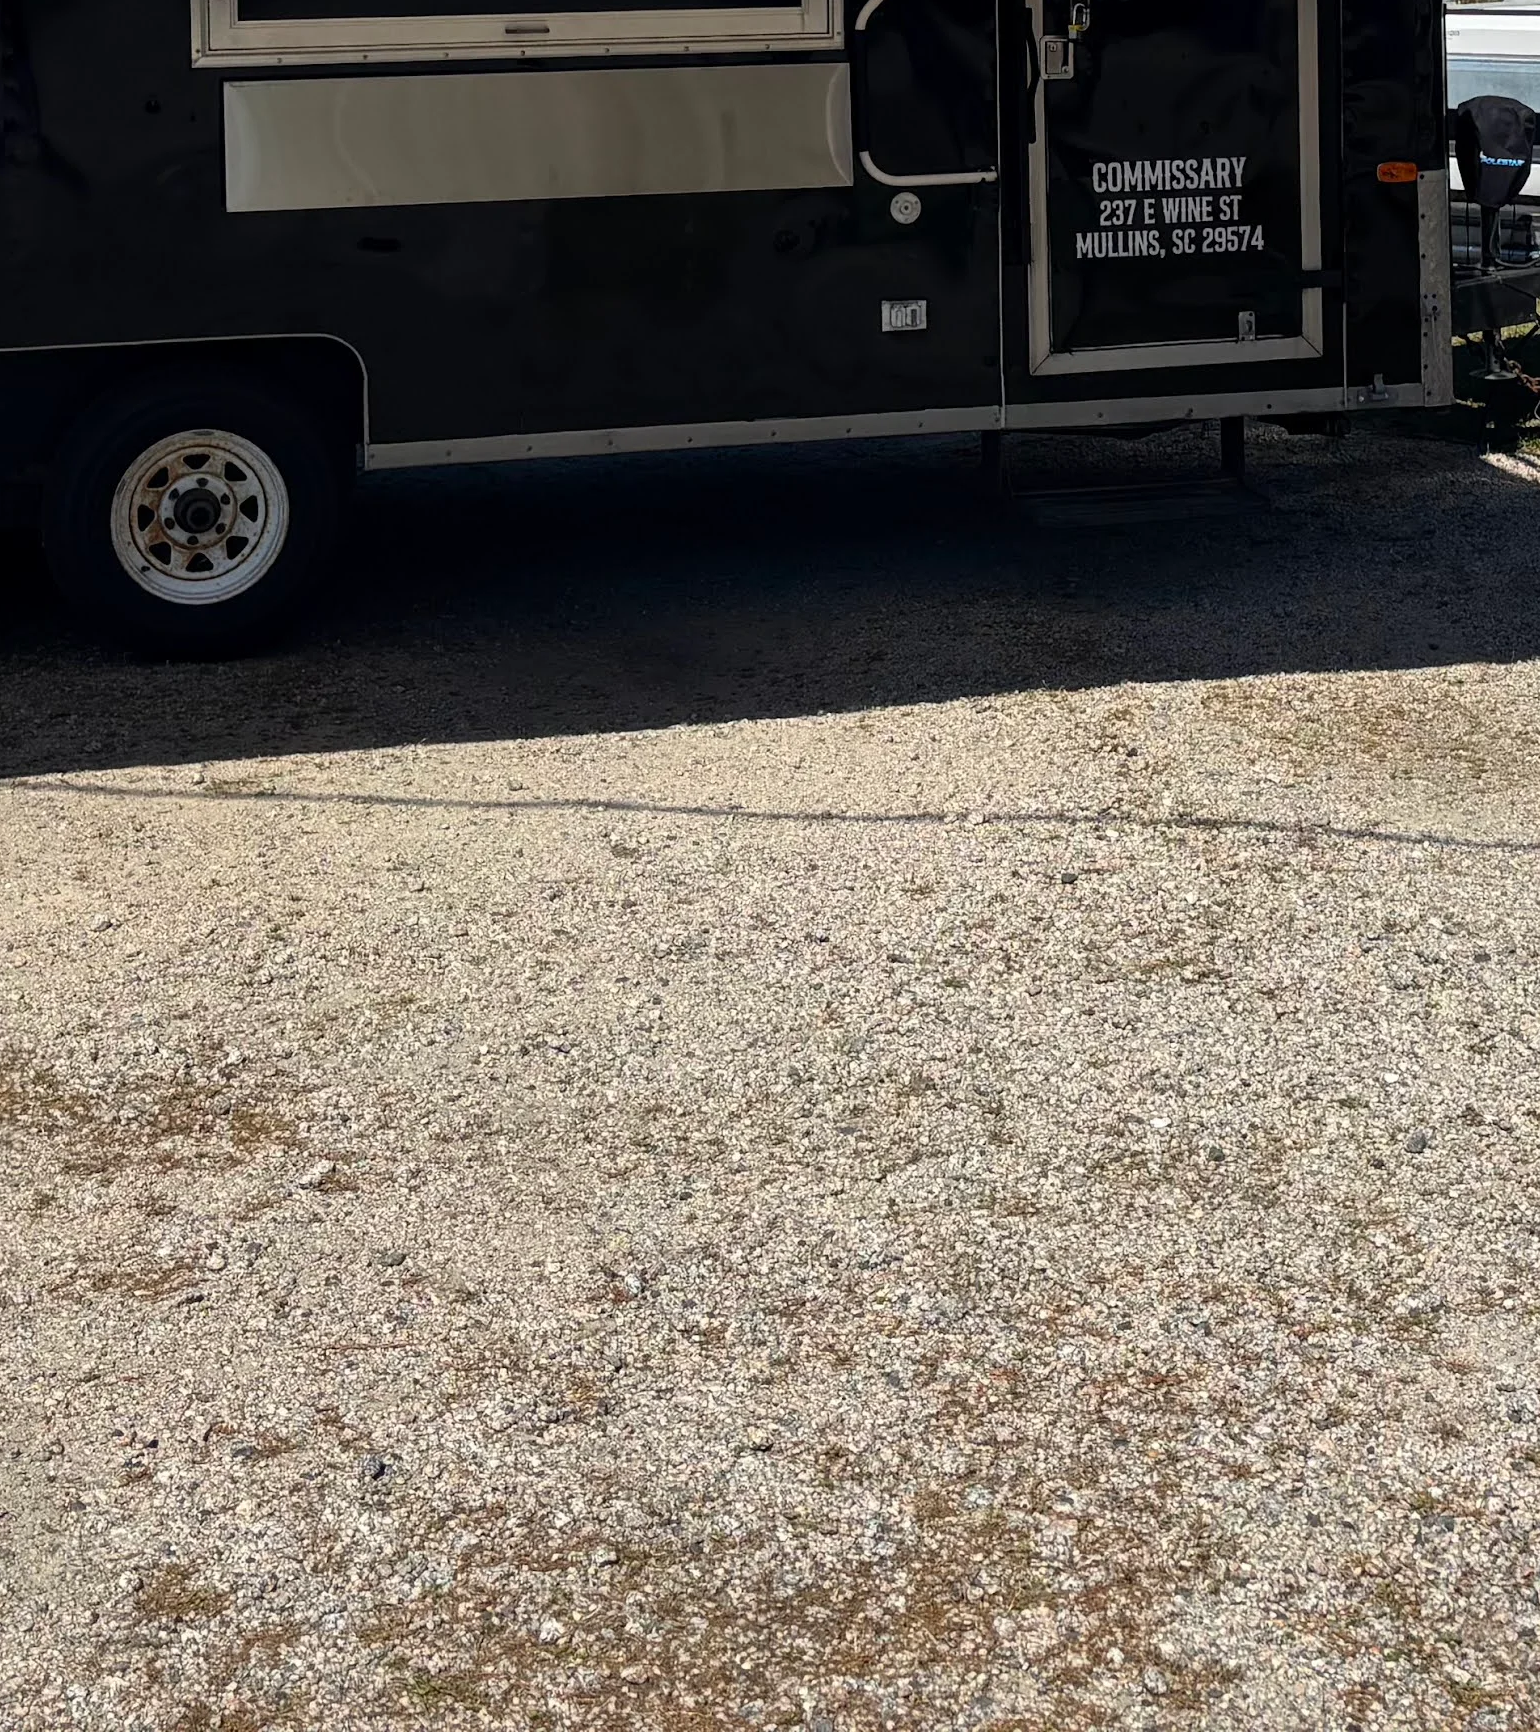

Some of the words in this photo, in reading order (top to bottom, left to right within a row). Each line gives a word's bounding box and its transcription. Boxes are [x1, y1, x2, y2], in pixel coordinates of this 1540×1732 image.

[1092, 156, 1247, 193] COMMISSARY
[1100, 199, 1137, 226] 237
[1144, 198, 1156, 224] E
[1162, 196, 1213, 223] WINE
[1219, 195, 1242, 220] ST
[1076, 230, 1166, 258] MULLINS,
[1172, 229, 1196, 254] SC
[1202, 225, 1264, 253] 29574
